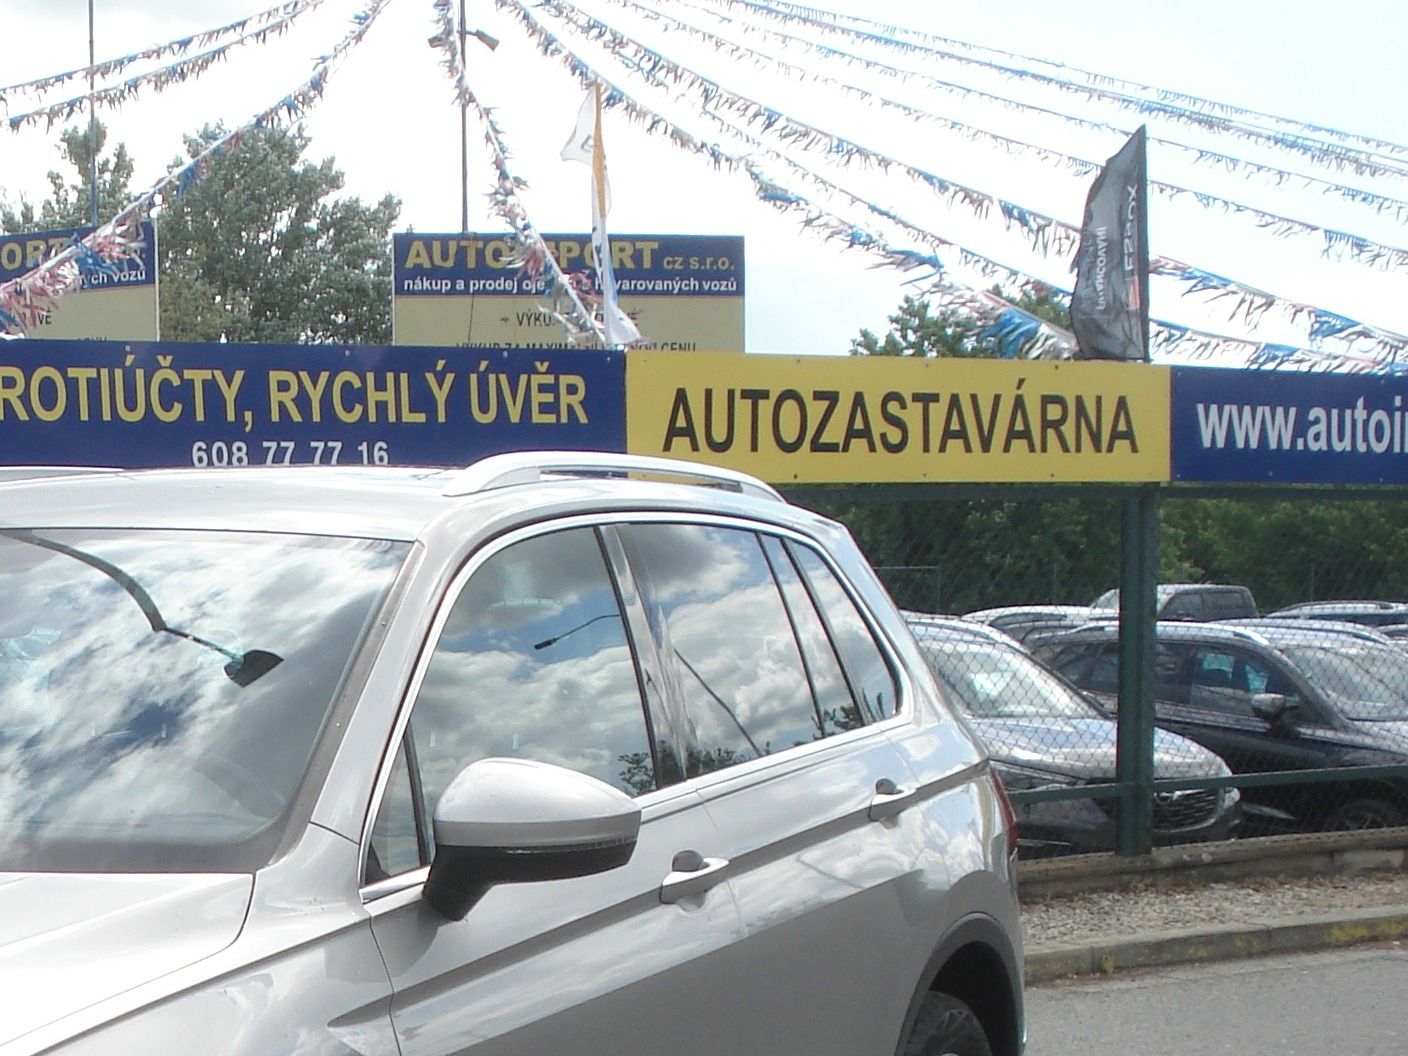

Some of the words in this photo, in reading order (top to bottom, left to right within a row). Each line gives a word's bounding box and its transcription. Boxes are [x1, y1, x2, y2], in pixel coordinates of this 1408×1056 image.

[664, 256, 684, 270] cz
[690, 256, 735, 270] s.r.o.
[404, 276, 451, 294] nákup
[456, 279, 465, 291] a
[469, 276, 518, 294] prodej
[595, 276, 699, 294] hvarovaných
[702, 277, 738, 291] vozů
[516, 308, 555, 327] VÝKU
[268, 359, 456, 424] RYCHLÝ
[469, 360, 589, 425] ÚVĚR
[662, 377, 1139, 454] AUTOZASTAVÁRNA
[1195, 395, 1408, 454] www.autoi
[192, 440, 248, 467] 608
[262, 440, 296, 466] 77
[309, 440, 343, 466] 77
[358, 440, 390, 466] 16
